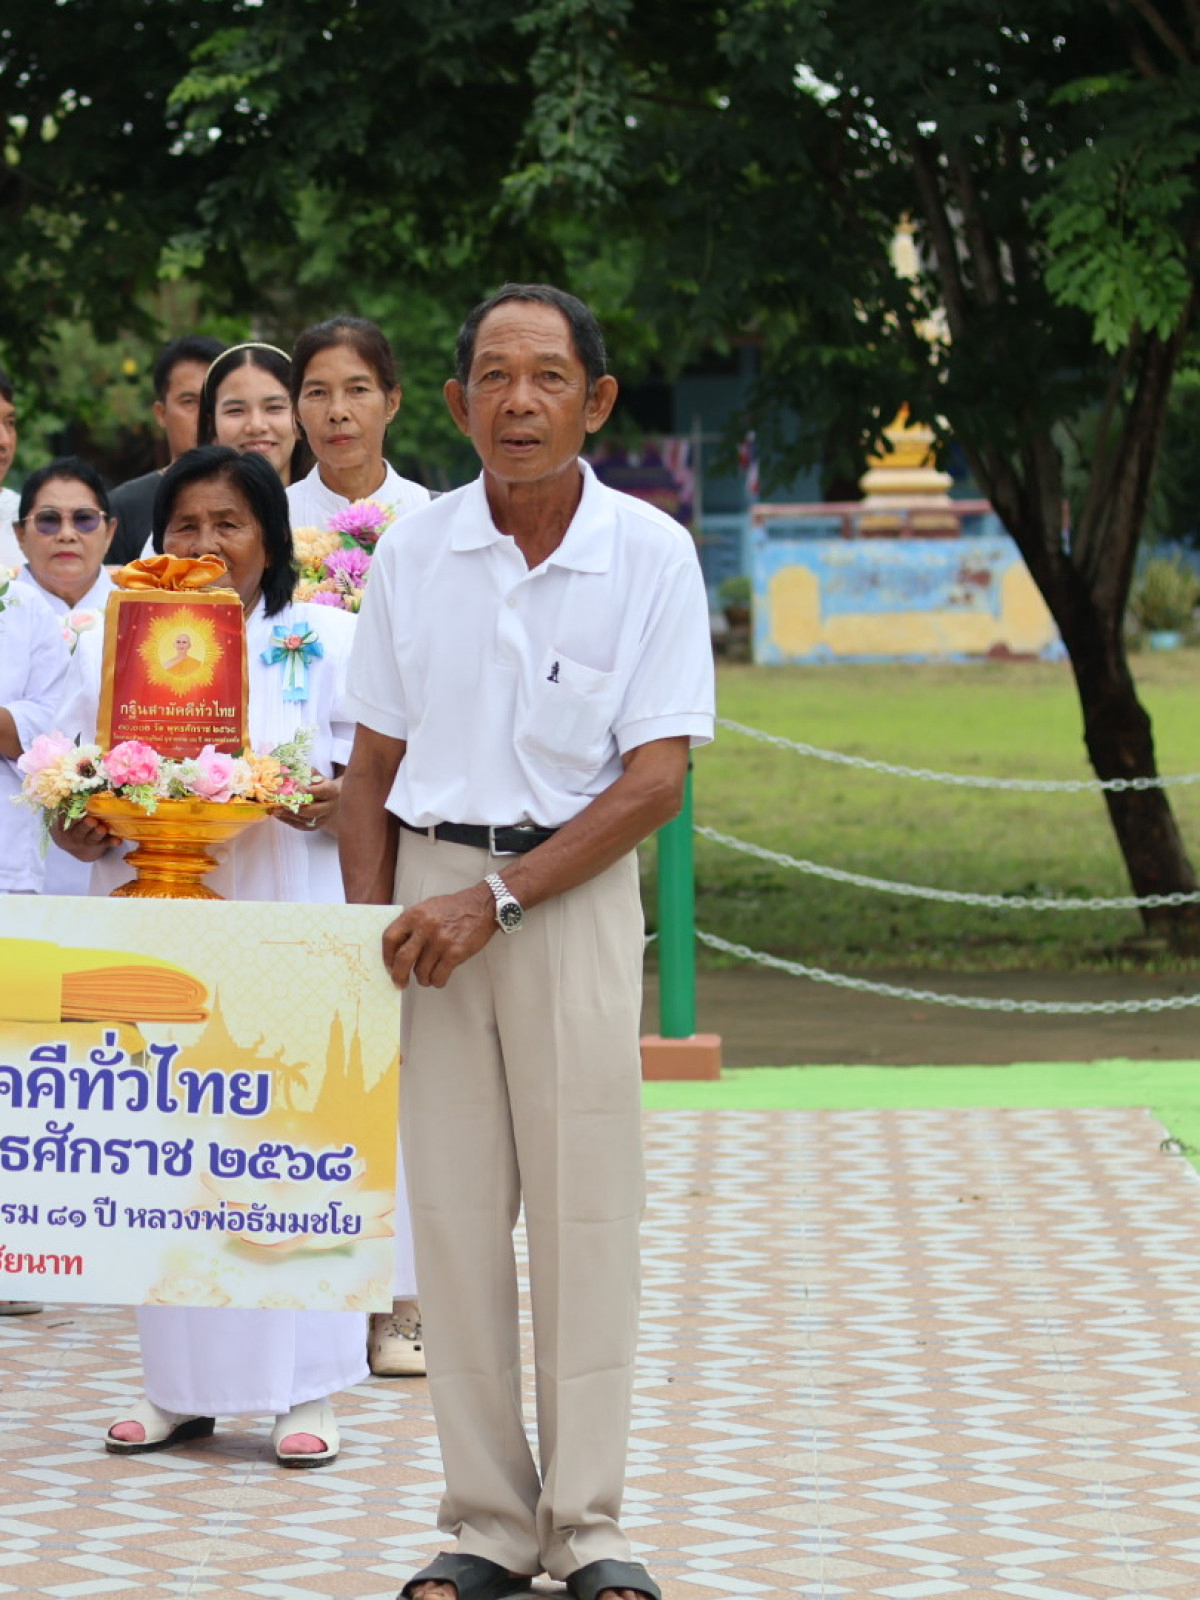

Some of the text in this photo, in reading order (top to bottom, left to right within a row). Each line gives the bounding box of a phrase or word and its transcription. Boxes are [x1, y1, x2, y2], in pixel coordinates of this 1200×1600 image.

[209, 1142, 354, 1182] ๒๕๖๘
[47, 1206, 87, 1228] ๘๑
[93, 1197, 117, 1228] ปี
[124, 1201, 362, 1236] หลวงพ่อธัมมชโย
